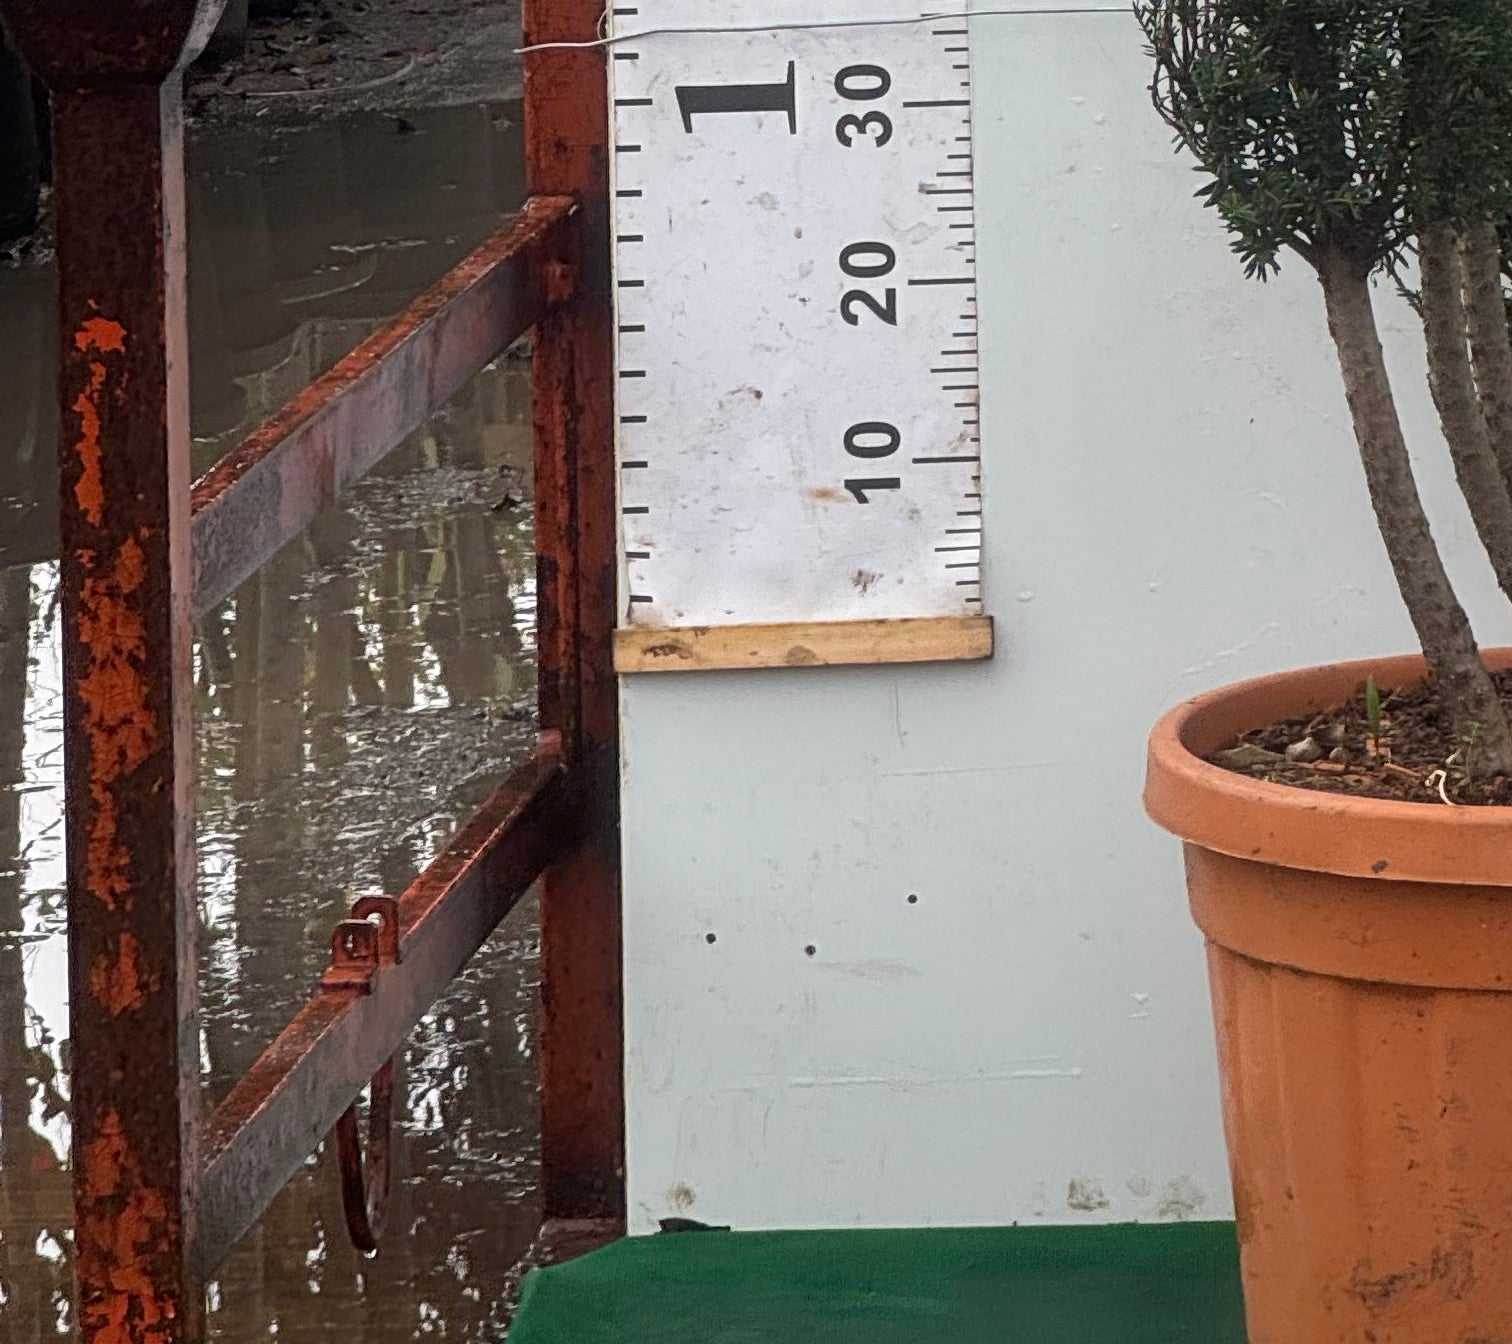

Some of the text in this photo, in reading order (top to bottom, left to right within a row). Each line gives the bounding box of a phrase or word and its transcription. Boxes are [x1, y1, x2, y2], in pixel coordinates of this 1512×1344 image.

[674, 60, 797, 135] 1
[833, 64, 893, 148] 30
[838, 241, 898, 327] 20
[843, 421, 901, 505] 10
